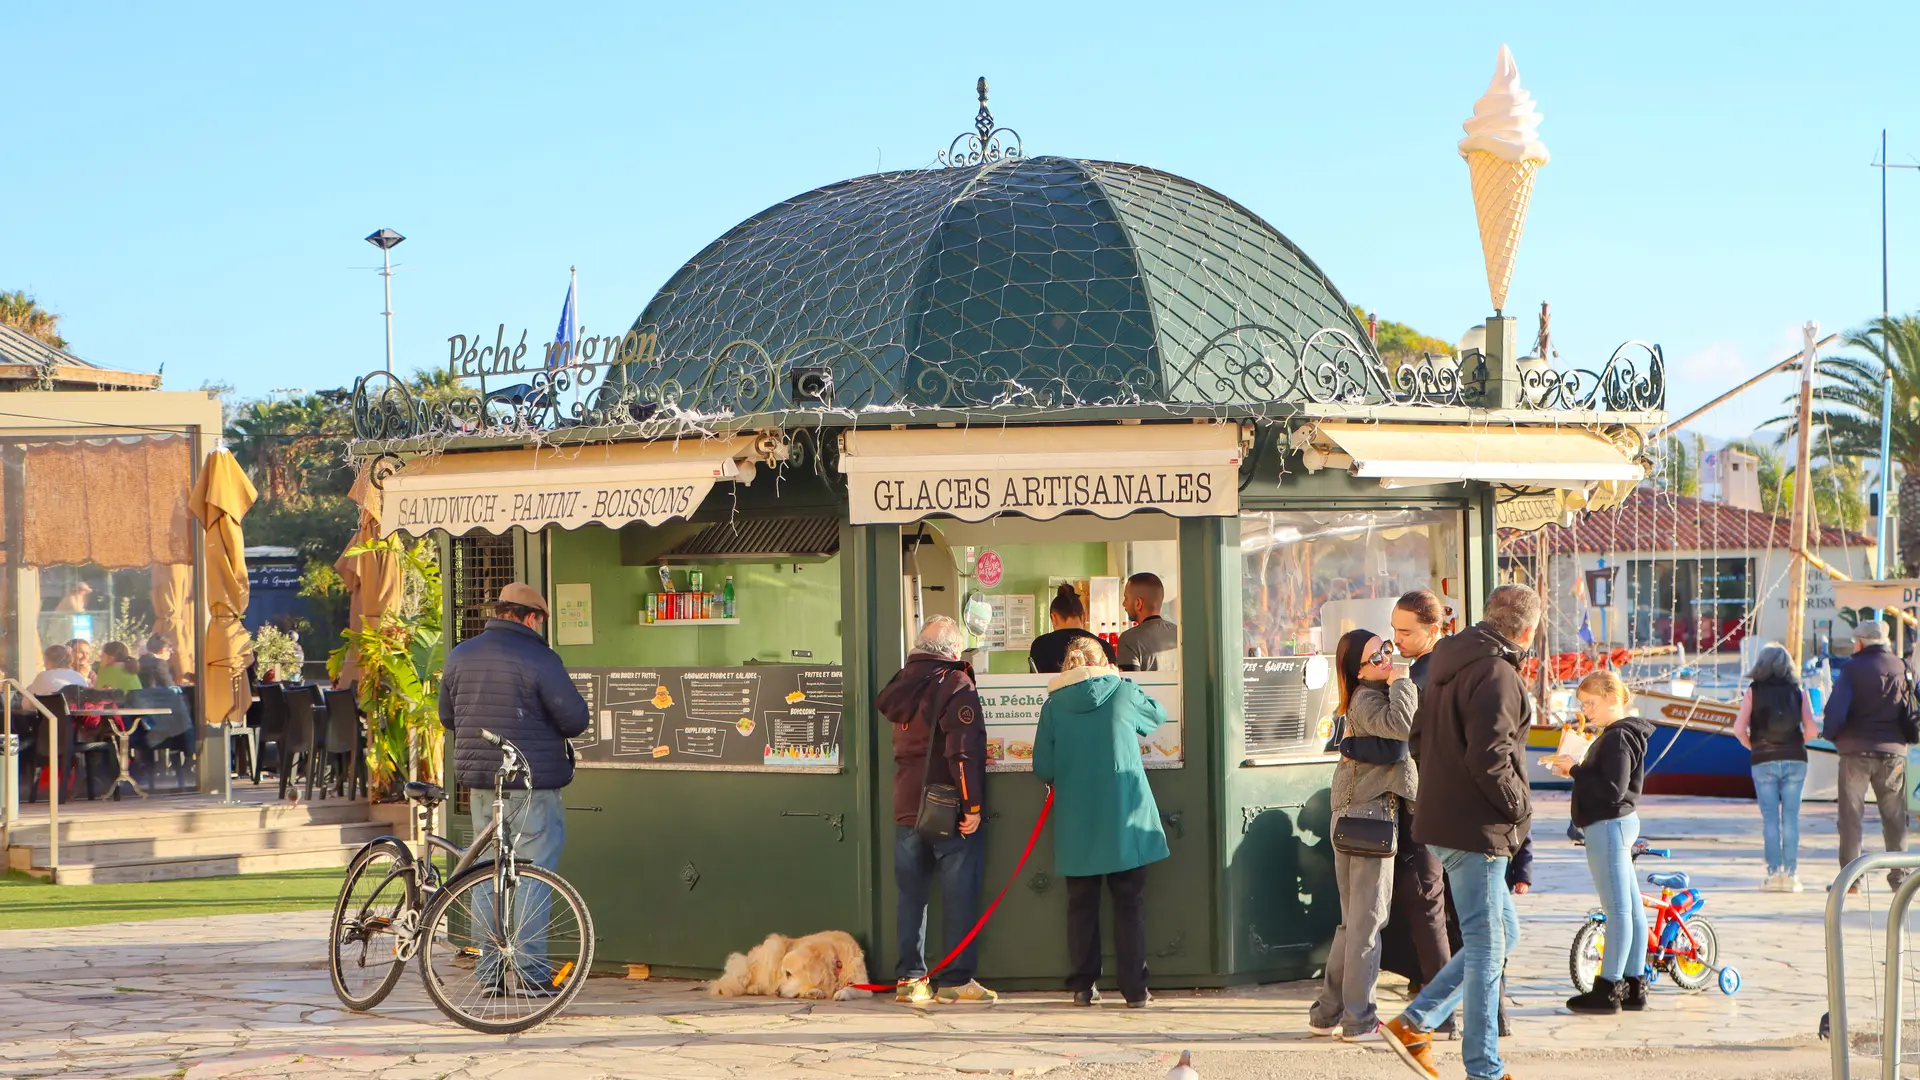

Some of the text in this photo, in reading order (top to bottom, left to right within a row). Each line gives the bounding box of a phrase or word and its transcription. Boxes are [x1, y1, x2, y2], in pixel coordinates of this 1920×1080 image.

[448, 323, 657, 386] Péché mignon
[397, 494, 498, 526] SANDWICH
[510, 490, 581, 522] PANINI
[592, 485, 694, 518] BOISSONS
[874, 472, 1211, 511] GLACES ARTISANALES
[978, 694, 1044, 706] Au Péché
[995, 711, 1032, 719] maison
[1671, 707, 1731, 724] PANELLERIA
